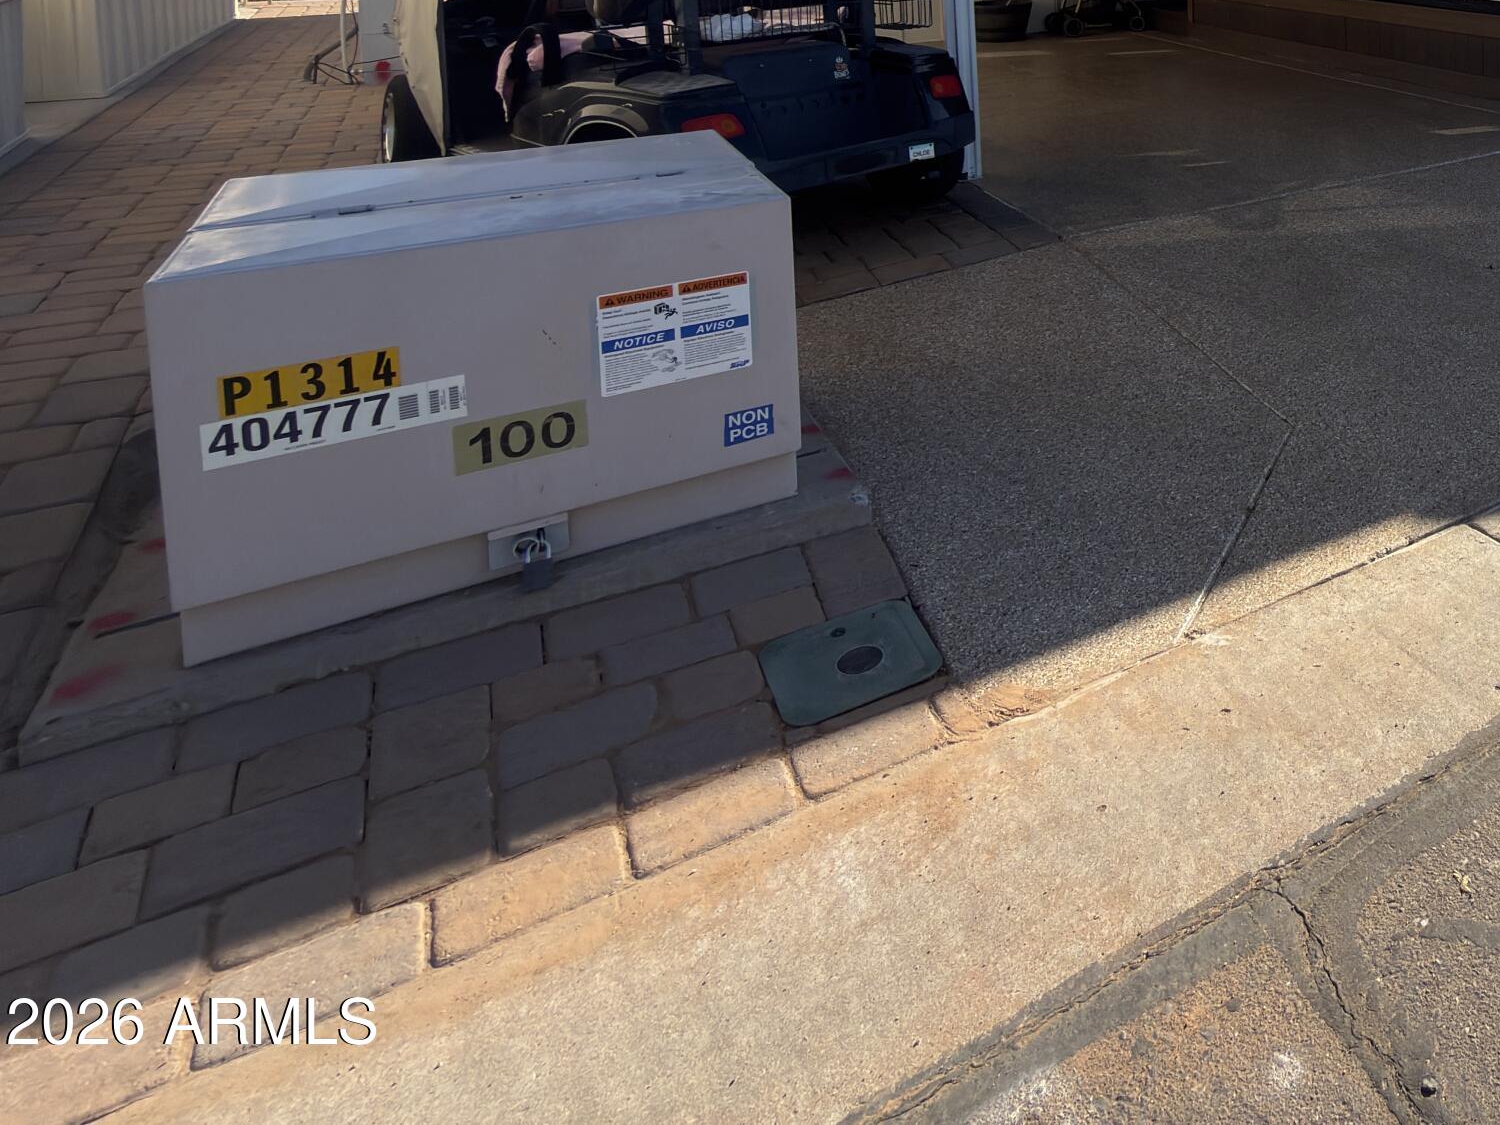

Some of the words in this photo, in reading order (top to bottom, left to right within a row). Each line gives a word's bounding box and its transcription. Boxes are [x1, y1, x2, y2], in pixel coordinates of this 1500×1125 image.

[692, 275, 746, 291] ADVERTENCIA
[617, 289, 668, 303] WARNING
[696, 320, 735, 334] AVISO
[614, 332, 664, 350] NOTICE
[223, 351, 396, 416] P1314
[208, 392, 391, 456] 404777
[729, 407, 769, 427] NON
[469, 412, 575, 464] 100
[730, 423, 768, 442] PCB
